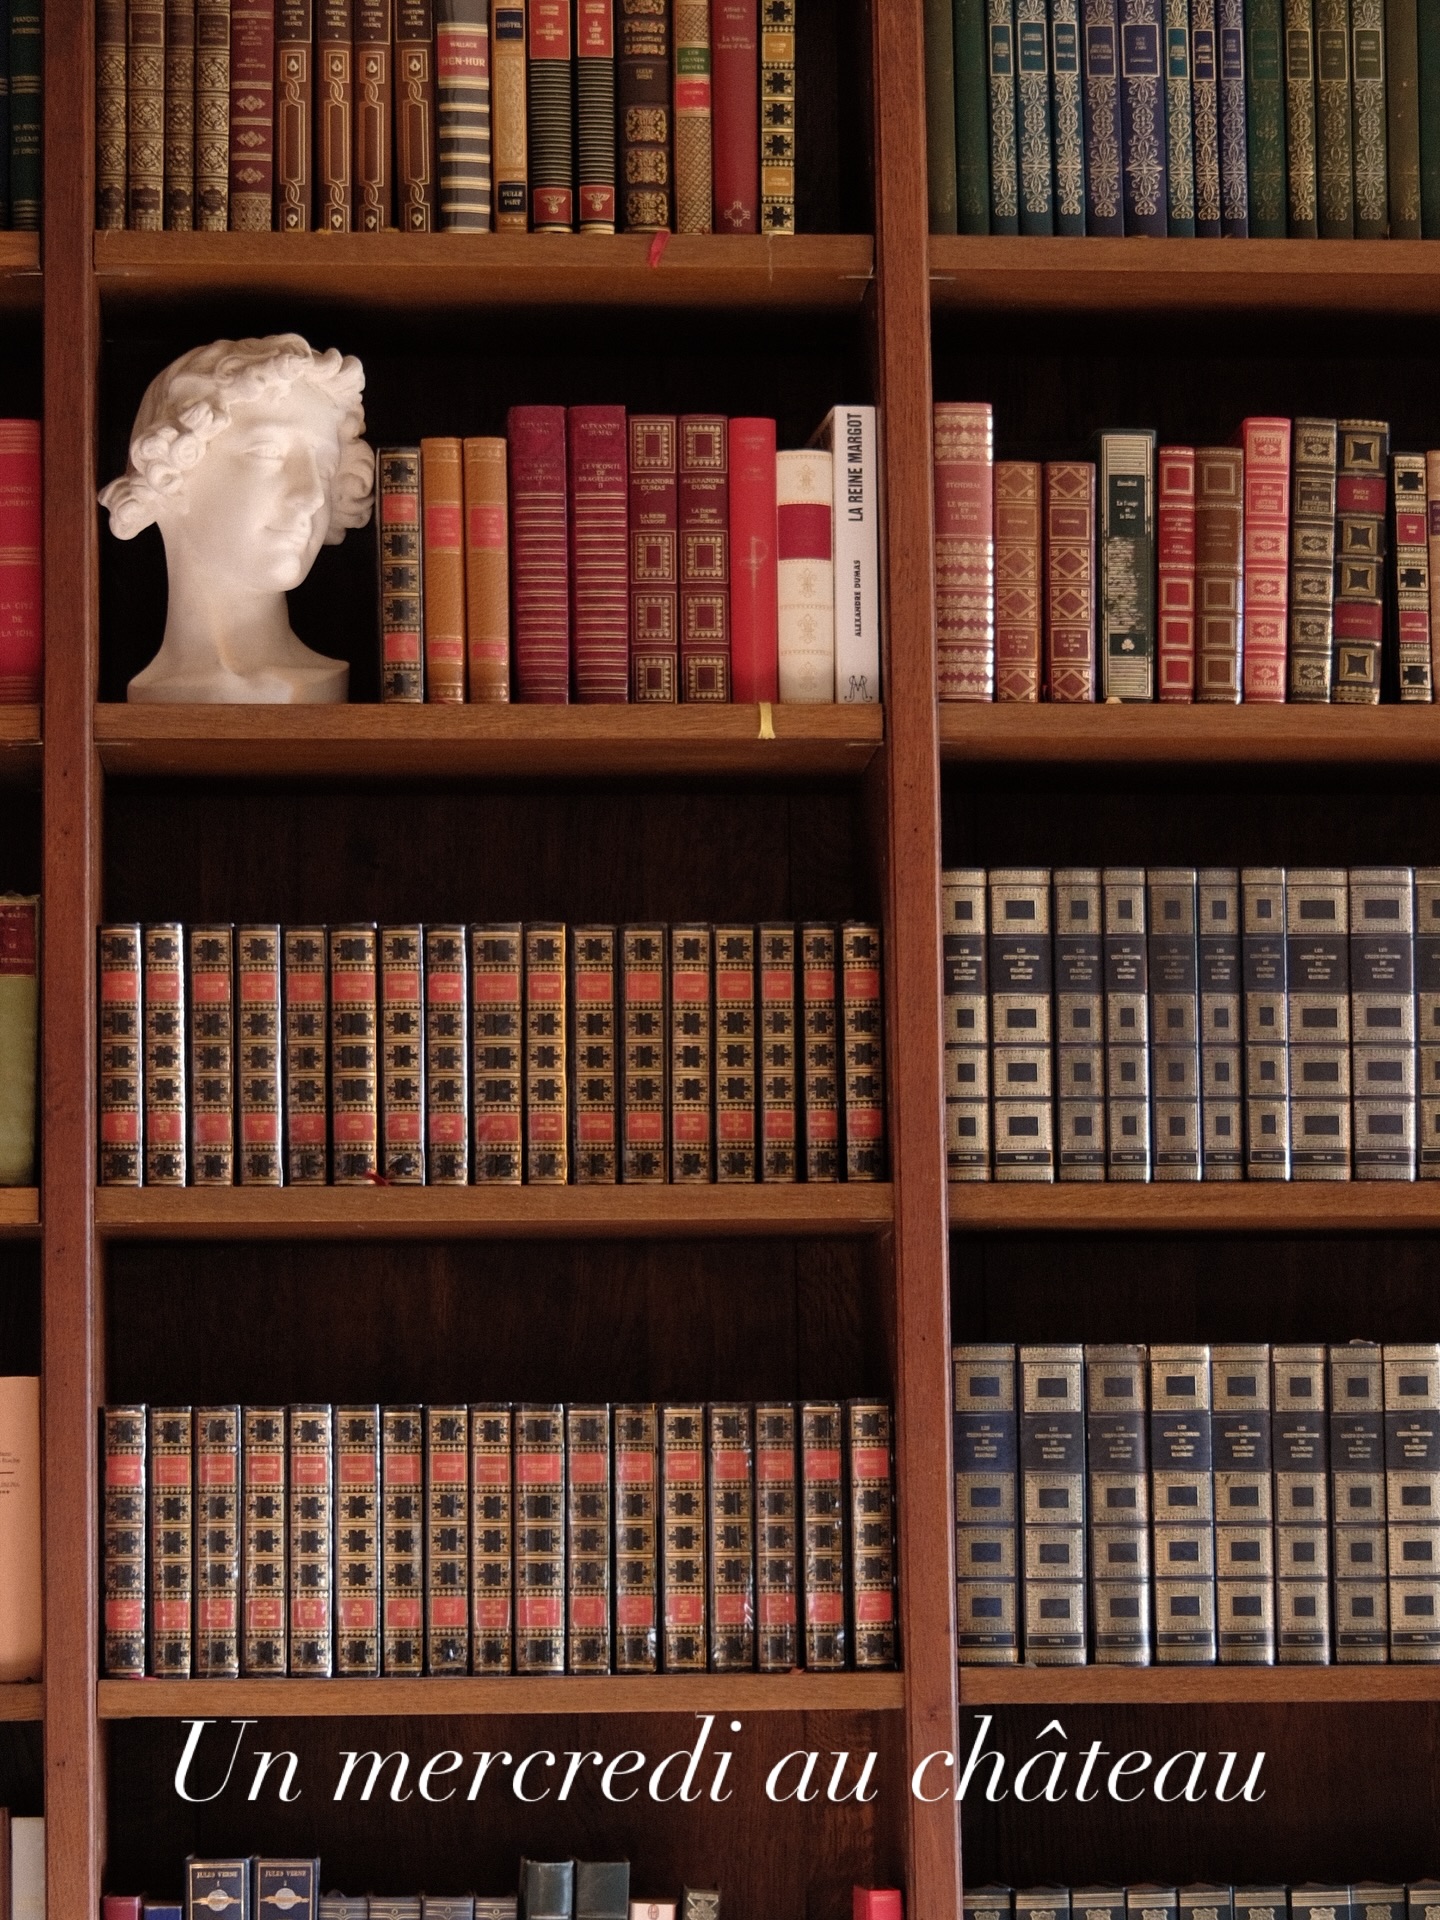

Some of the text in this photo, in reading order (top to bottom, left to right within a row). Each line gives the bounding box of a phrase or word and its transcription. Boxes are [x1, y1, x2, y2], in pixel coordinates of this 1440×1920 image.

[442, 56, 485, 67] BEN-HUR
[847, 413, 863, 522] LA REINE MARGOT
[854, 592, 862, 637] ALEXANDRE
[12, 616, 22, 624] DE
[1, 630, 12, 638] LA
[197, 1870, 238, 1879] JULES VERNE
[265, 1870, 284, 1878] JULES
